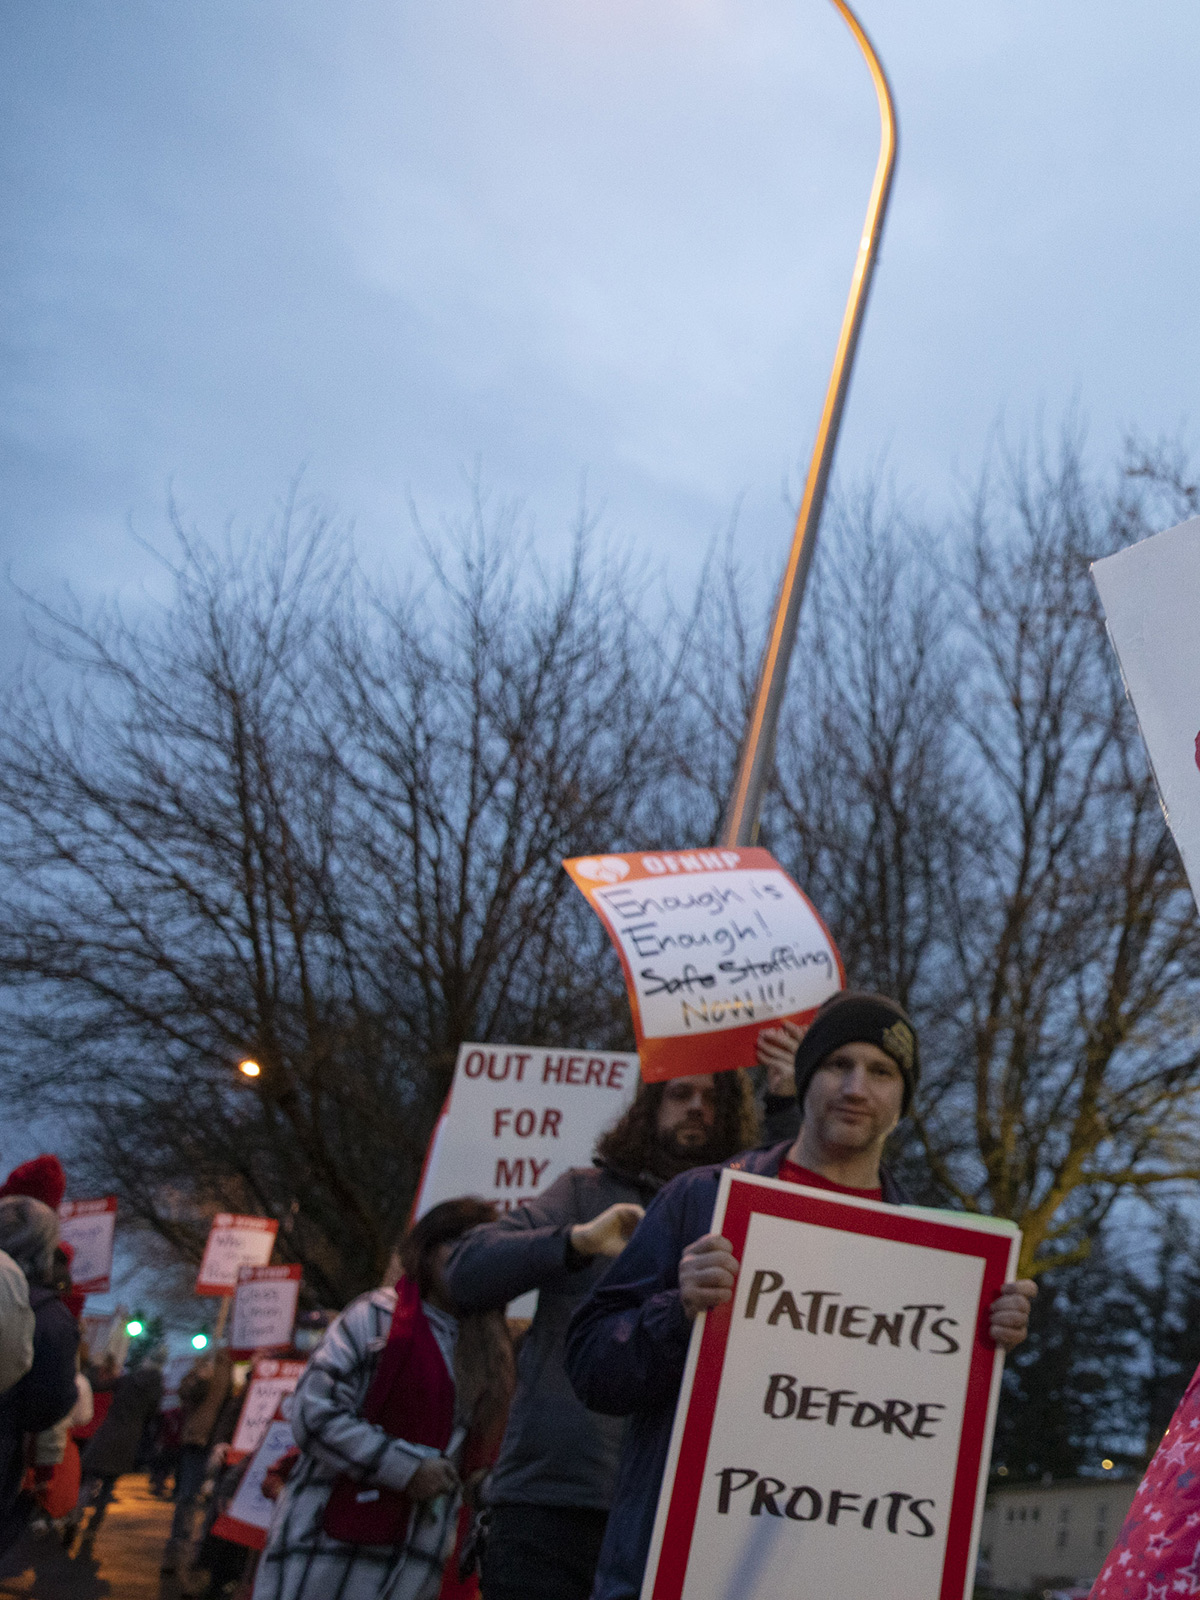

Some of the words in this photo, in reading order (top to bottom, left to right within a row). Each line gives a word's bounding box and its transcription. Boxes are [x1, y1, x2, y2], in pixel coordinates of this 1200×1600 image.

[641, 851, 741, 874] OFNHP
[601, 883, 742, 919] Enough
[751, 880, 784, 900] is
[621, 910, 773, 957] Enough!
[641, 964, 716, 996] Safe
[719, 942, 834, 984] Staffing
[464, 1050, 532, 1082] OUT
[542, 1055, 630, 1089] HERE
[494, 1108, 563, 1138] FOR
[494, 1158, 550, 1188] MY
[743, 1269, 960, 1355] PATIENTS
[762, 1372, 947, 1440] BEFORE
[714, 1467, 936, 1538] PROFITS
